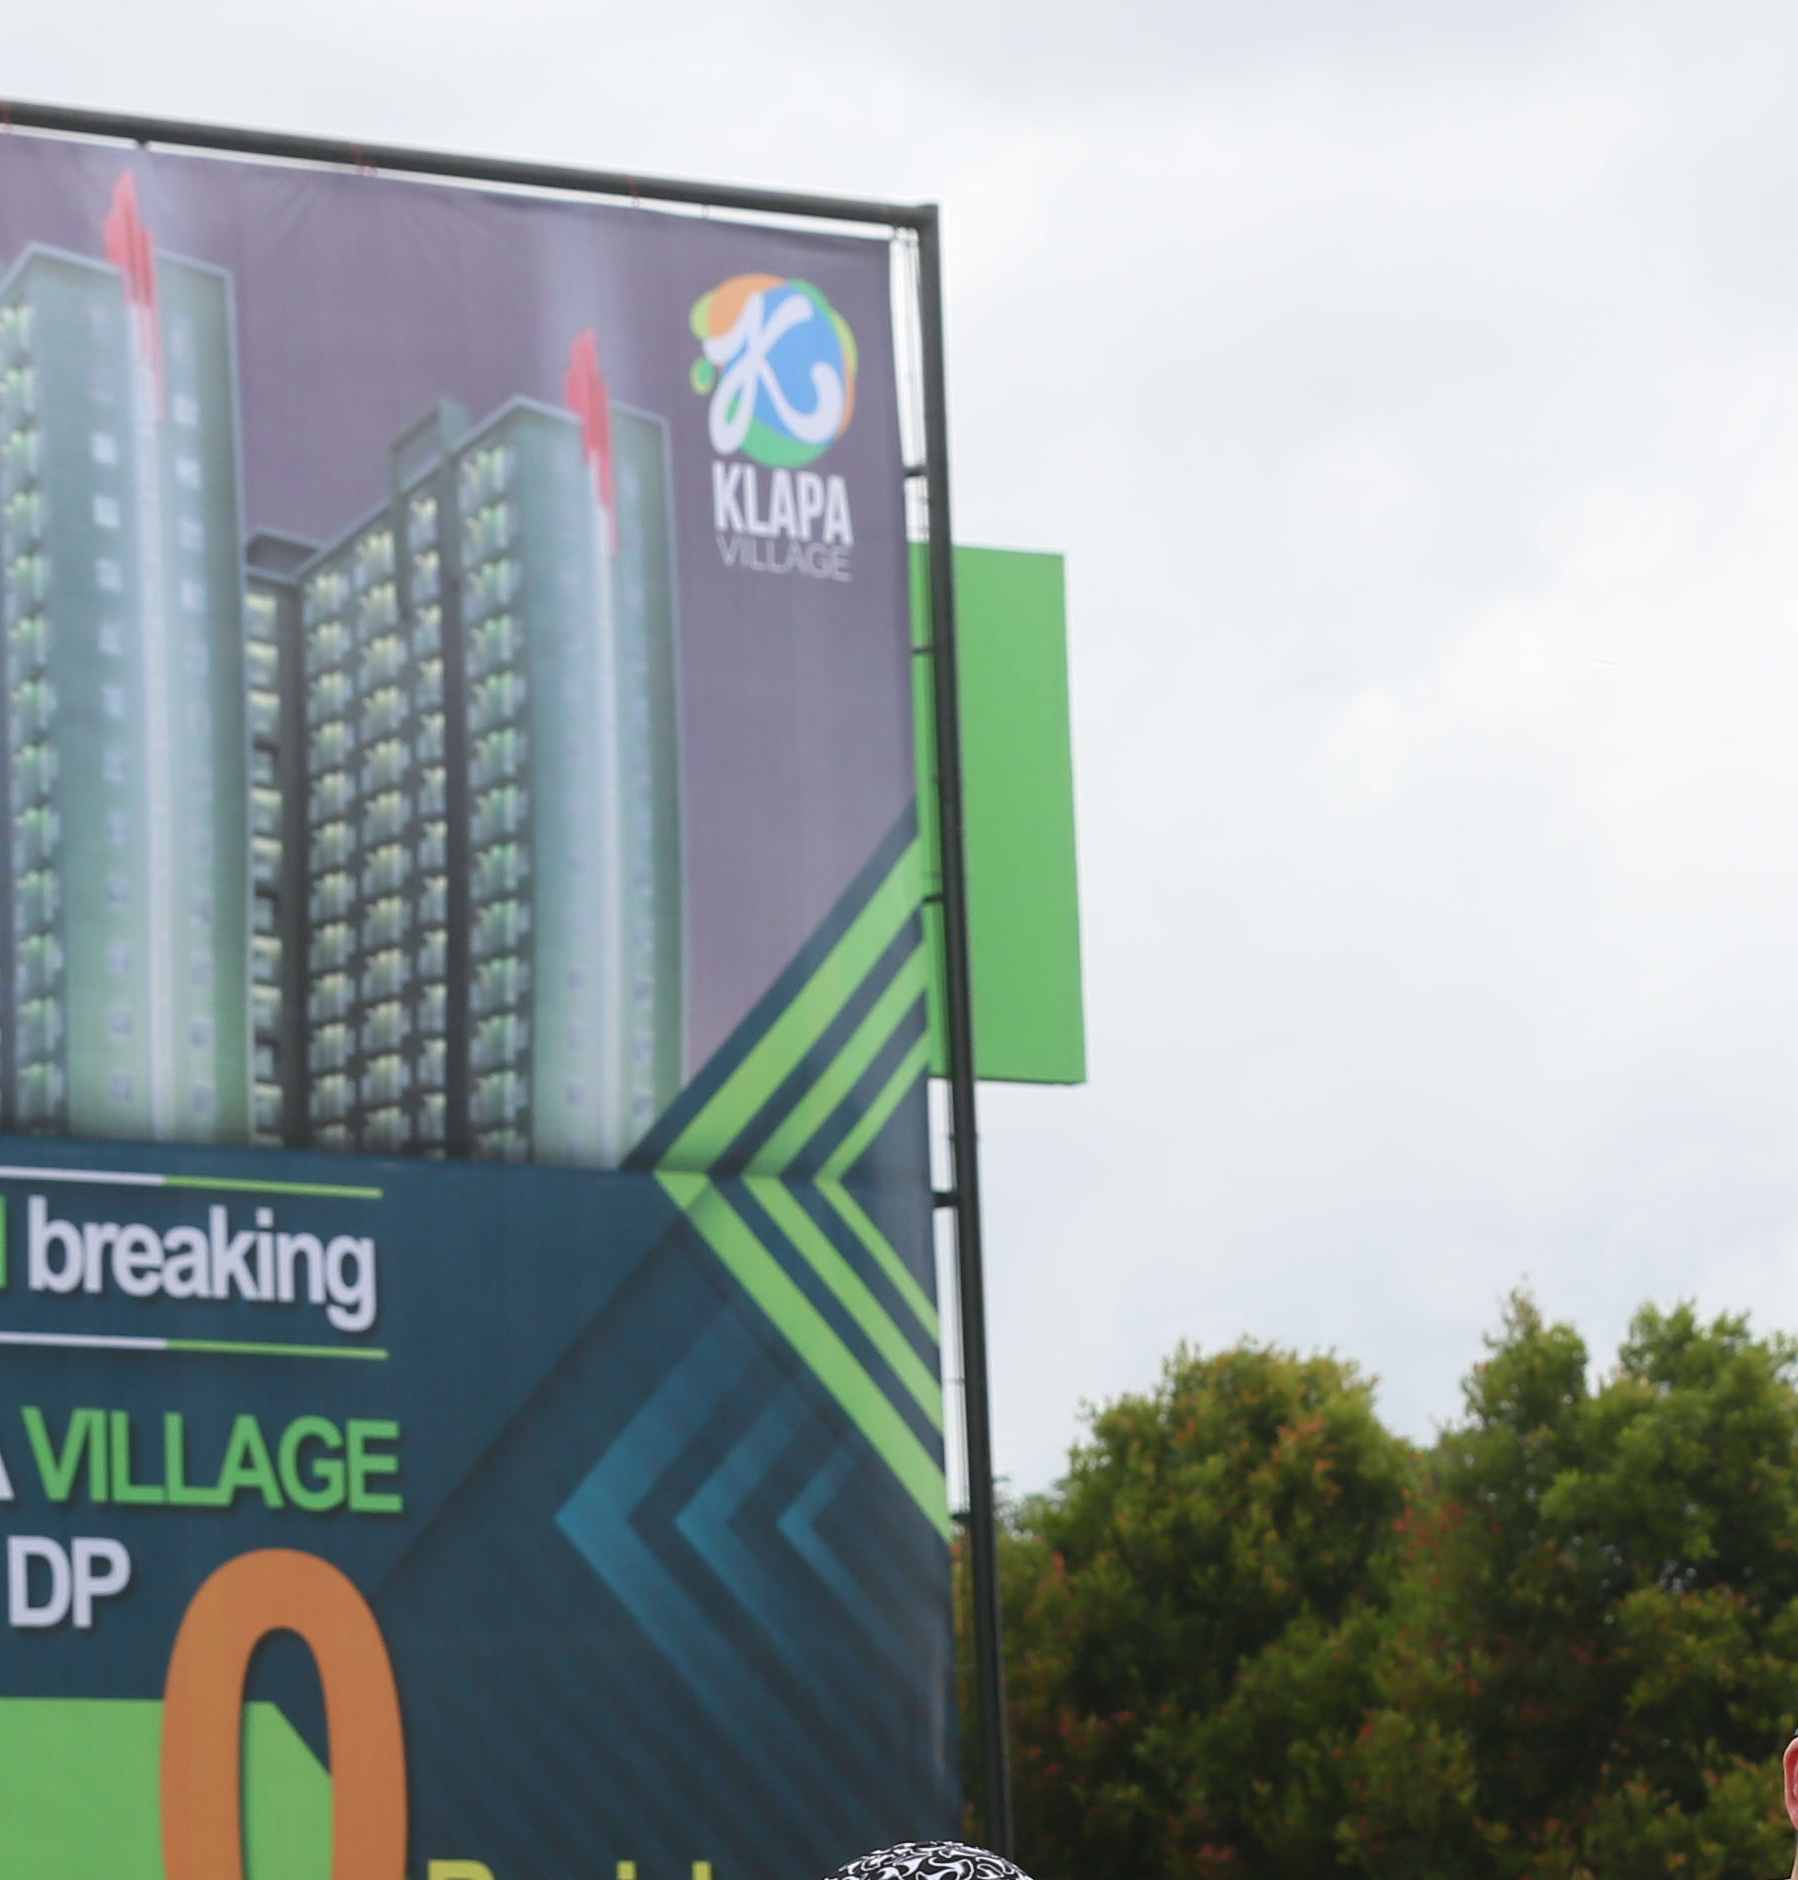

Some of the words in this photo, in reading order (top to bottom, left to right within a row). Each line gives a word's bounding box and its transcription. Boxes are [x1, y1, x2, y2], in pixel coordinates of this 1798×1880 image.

[711, 460, 853, 546] KLAPA
[715, 535, 853, 582] VILLAGE
[27, 1195, 378, 1333] breaking
[22, 1405, 404, 1514] VILLAGE
[6, 1533, 132, 1629] DP
